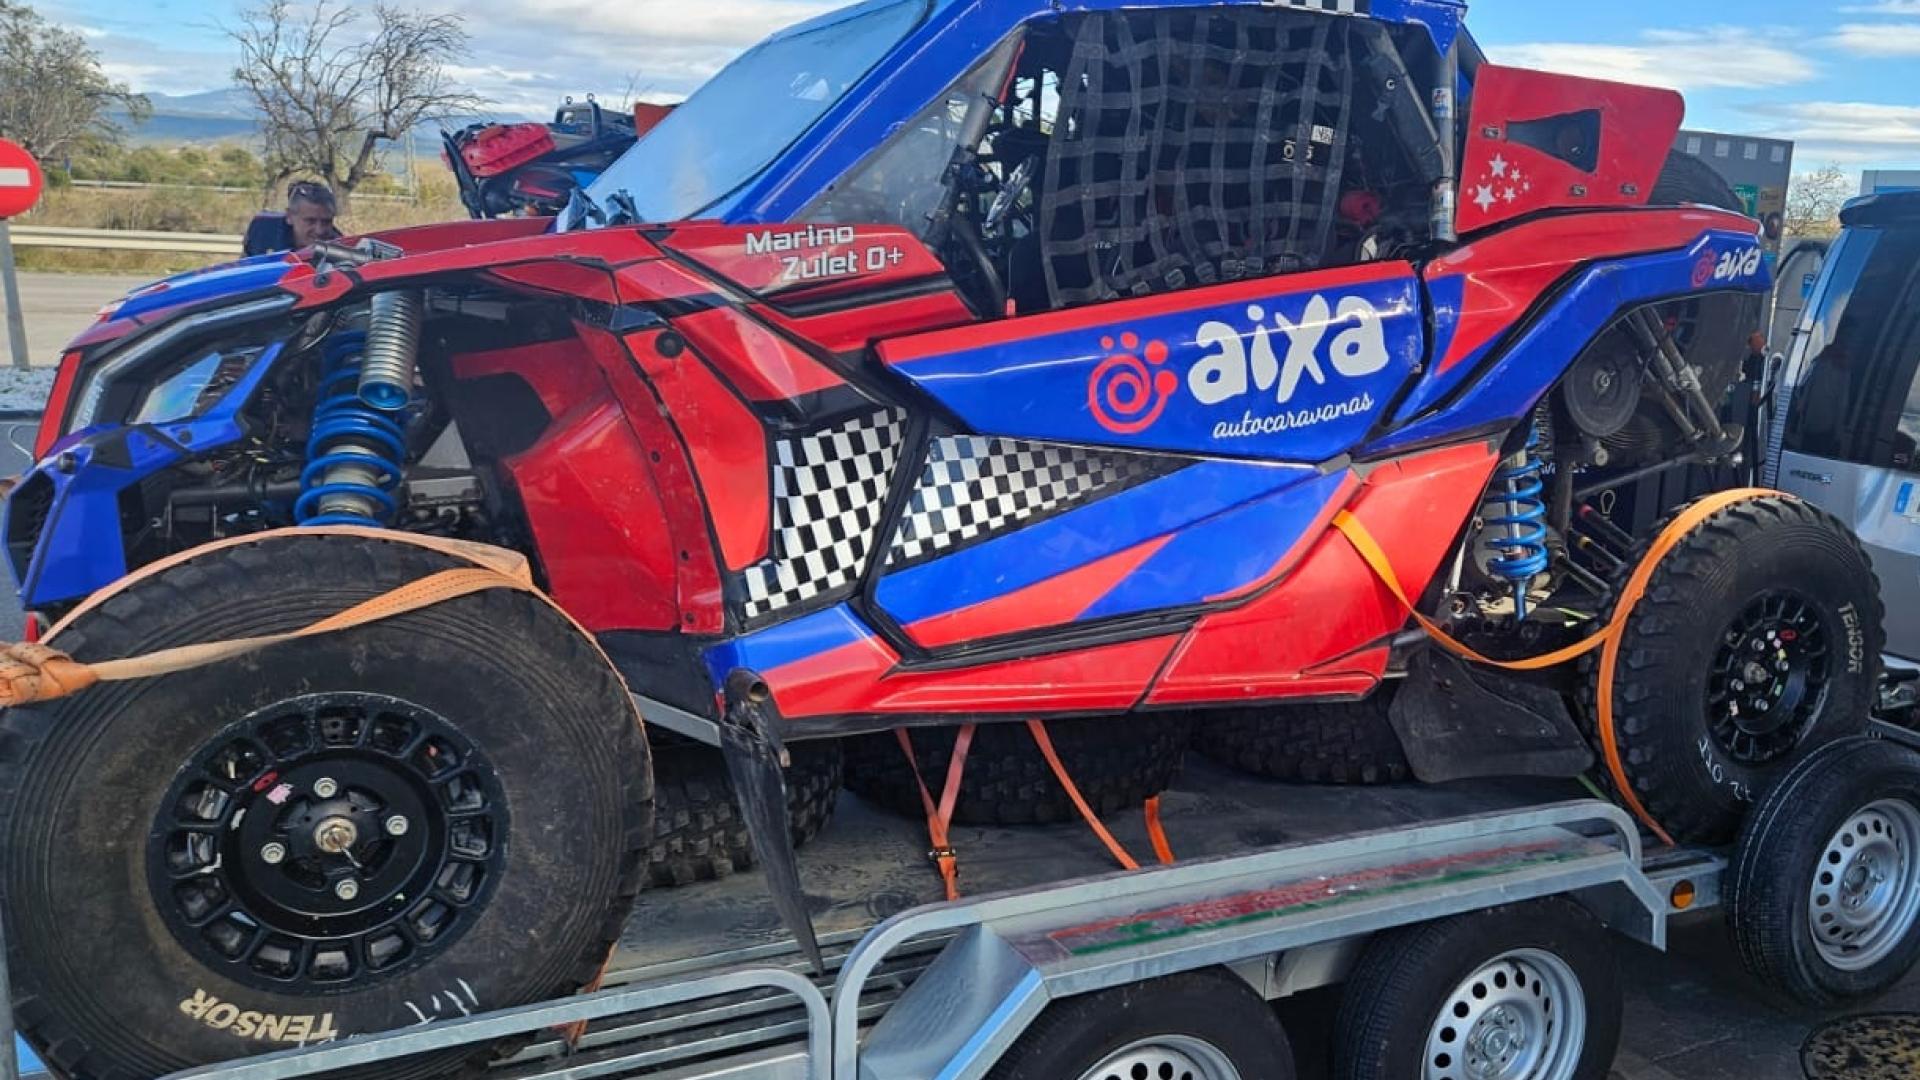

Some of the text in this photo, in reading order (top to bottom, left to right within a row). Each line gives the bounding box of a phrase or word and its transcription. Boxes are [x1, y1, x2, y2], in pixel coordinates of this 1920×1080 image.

[746, 224, 854, 255] Marino
[781, 250, 859, 281] Zulet
[1714, 247, 1761, 281] aixa
[1187, 294, 1390, 405] aixa
[1213, 392, 1374, 439] autocaravanas
[179, 988, 338, 1042] TENSOR
